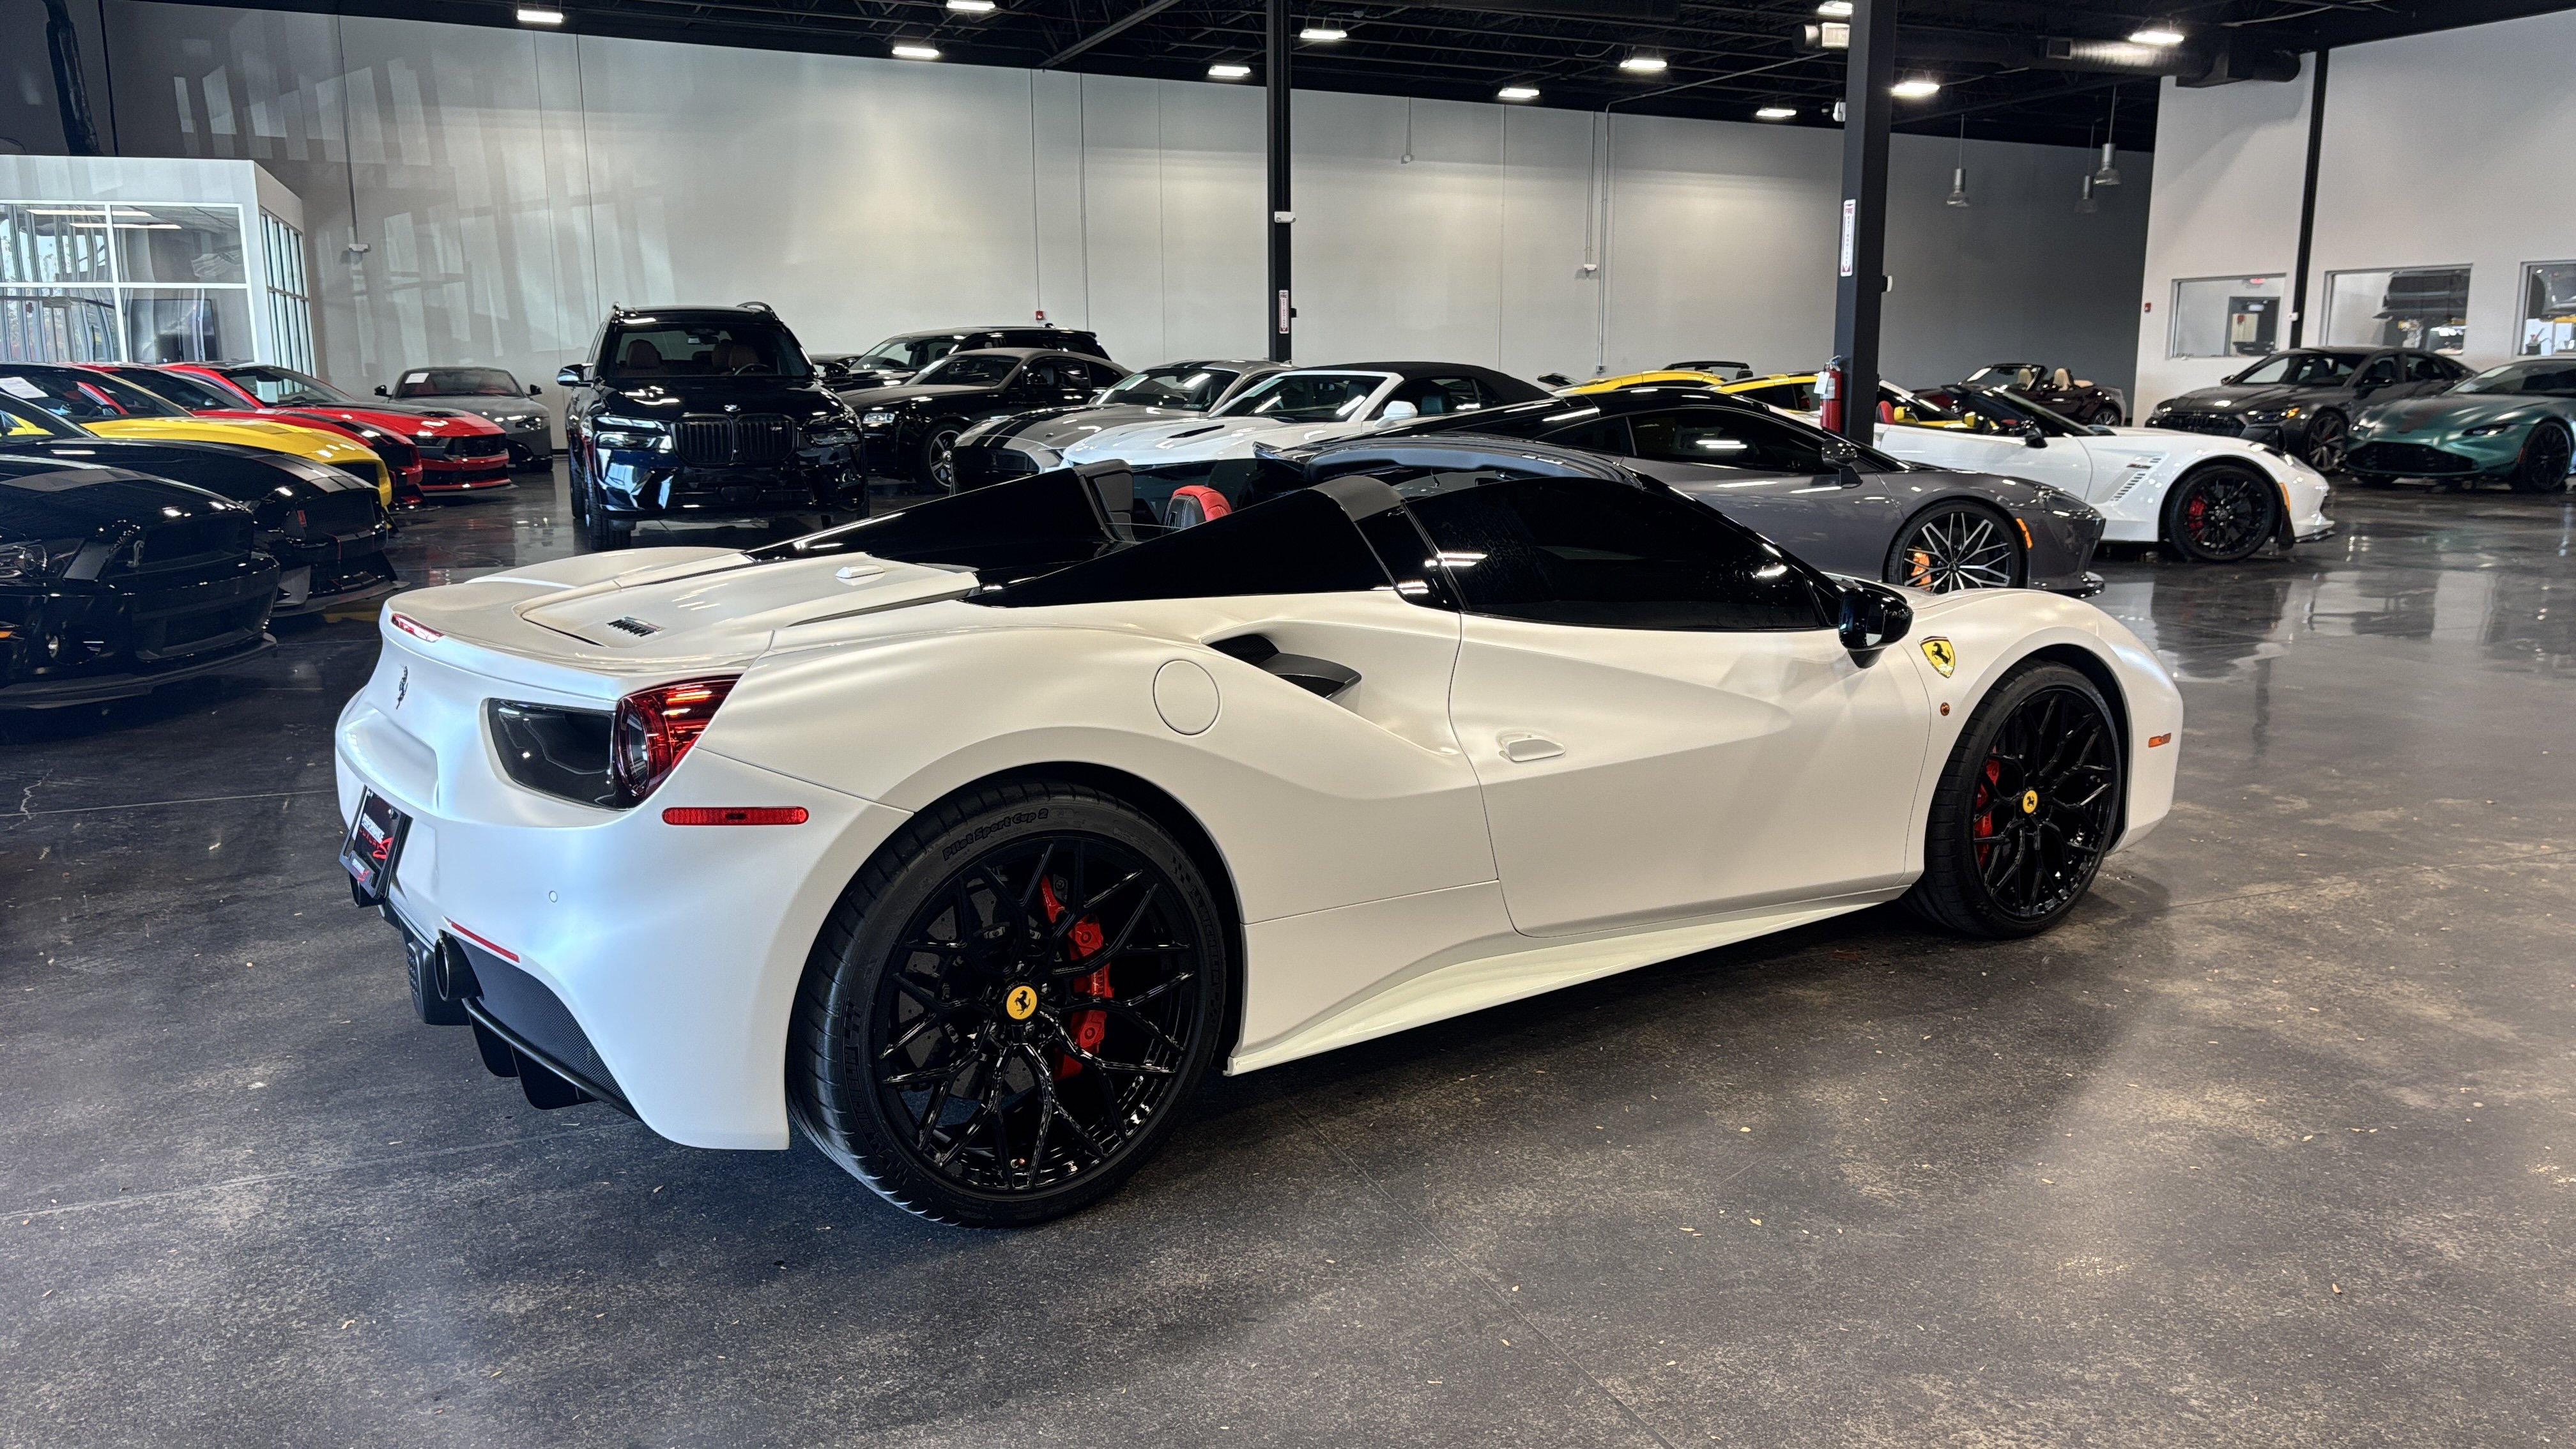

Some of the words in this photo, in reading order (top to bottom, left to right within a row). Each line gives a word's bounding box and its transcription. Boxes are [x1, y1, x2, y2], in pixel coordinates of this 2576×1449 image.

[942, 833, 974, 861] Pilot
[974, 816, 1011, 841] Sport
[1011, 812, 1037, 824] Cup
[1038, 808, 1048, 819] 2
[845, 1047, 875, 1134] MICHELIN
